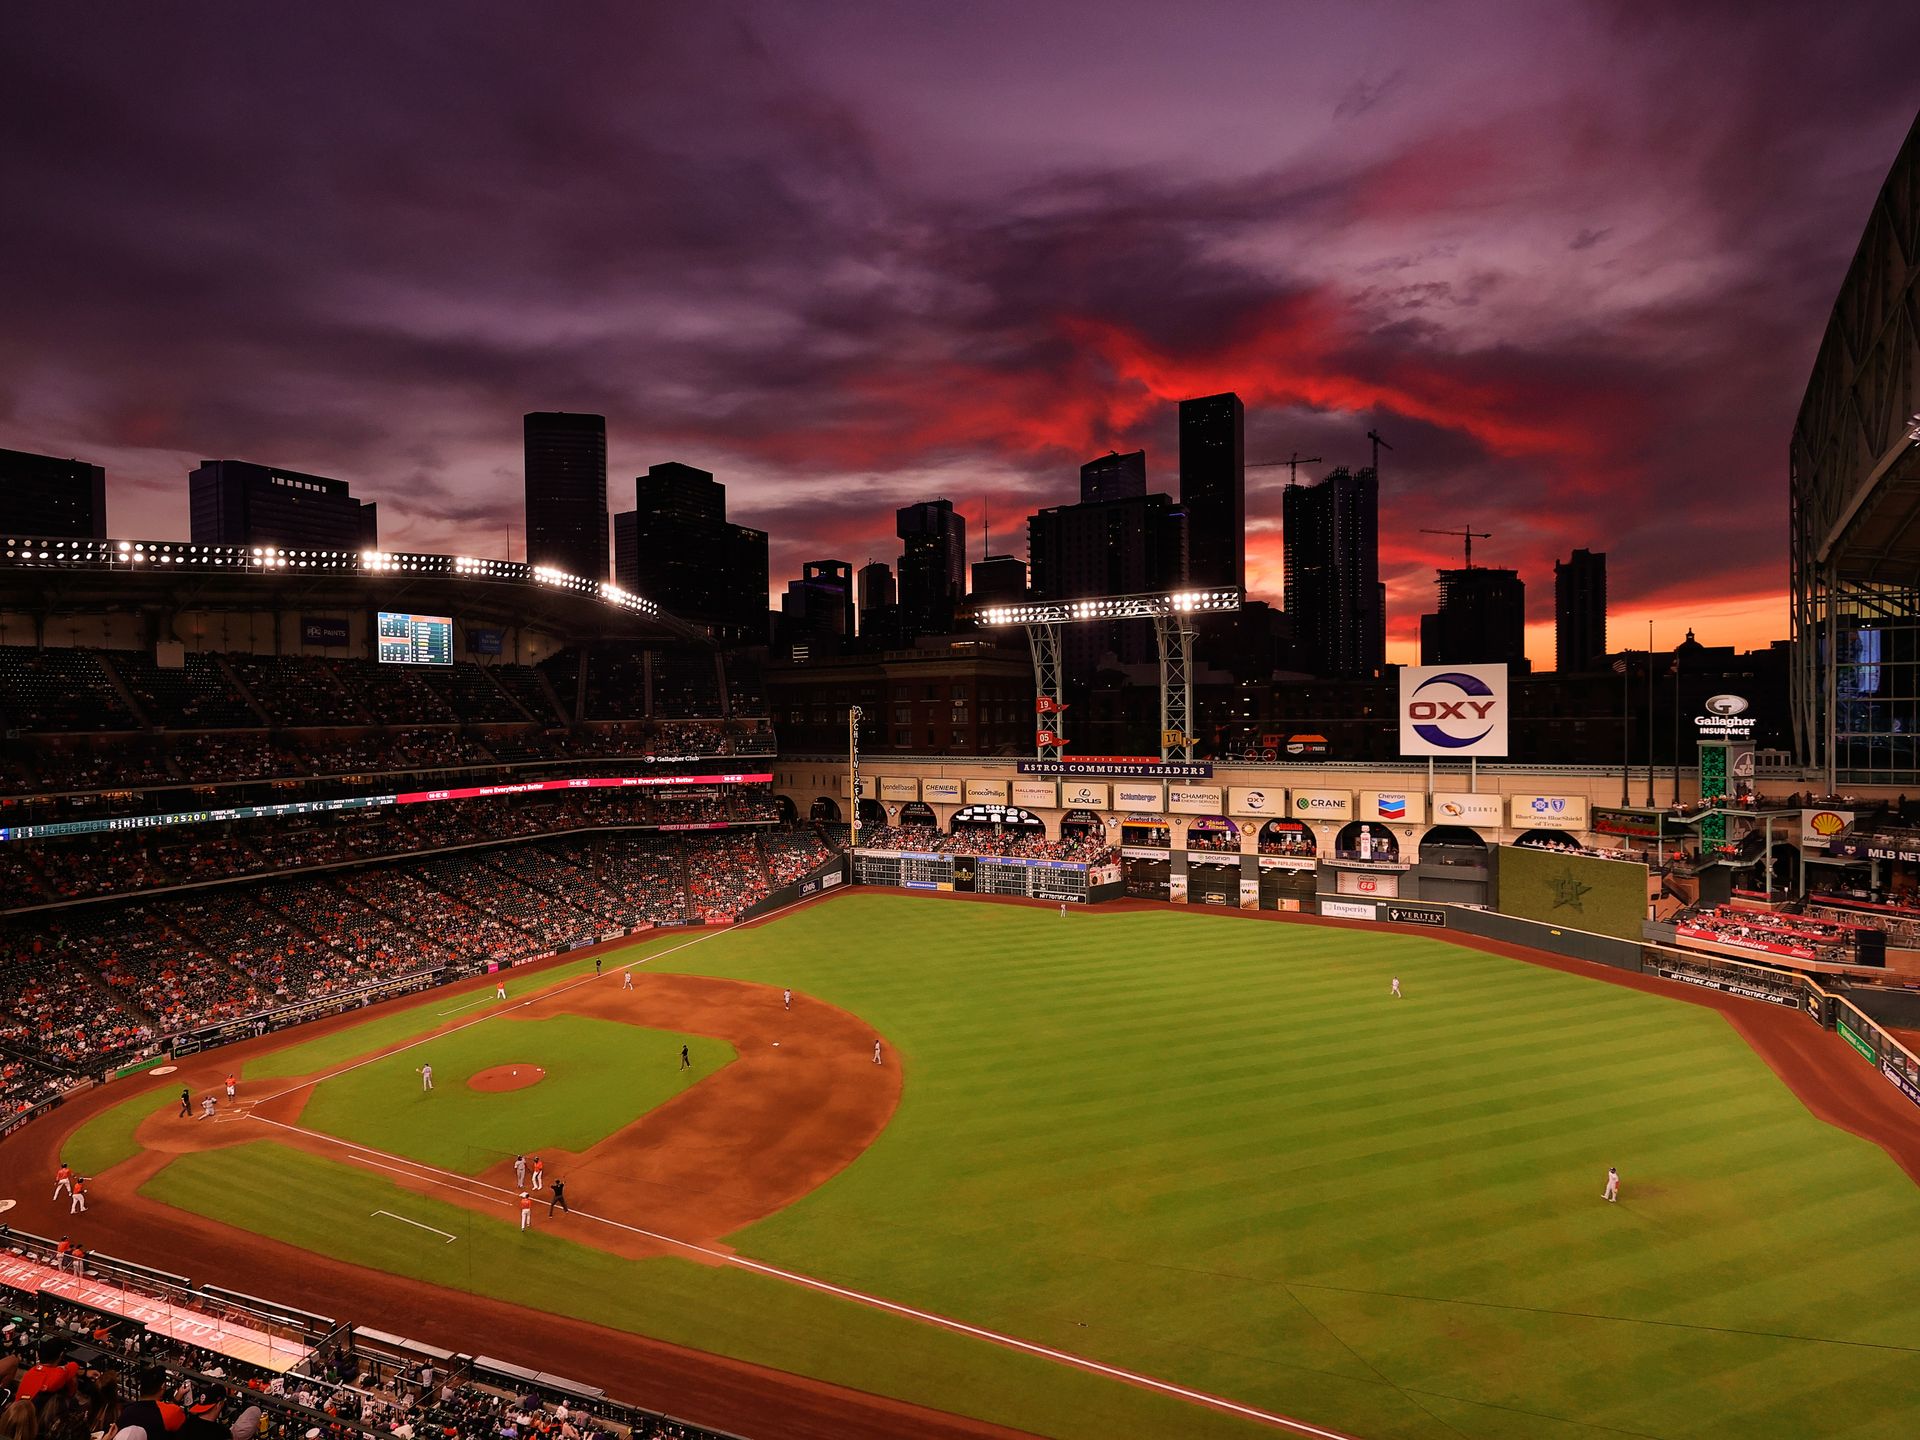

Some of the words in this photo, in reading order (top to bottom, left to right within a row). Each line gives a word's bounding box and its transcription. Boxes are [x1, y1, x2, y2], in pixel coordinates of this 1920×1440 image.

[324, 629, 346, 637] PAINTS
[1410, 701, 1496, 720] OXY
[1694, 716, 1756, 727] Gallagher
[1040, 734, 1049, 742] 05
[1166, 734, 1176, 742] 17
[1070, 764, 1144, 774] COMMUNITY
[1149, 766, 1206, 775] LEADERS
[968, 789, 1005, 798] ConocoPhillips
[1120, 792, 1156, 802] Schlumberger
[1310, 799, 1346, 808] CRANE
[1868, 848, 1896, 859] MLB
[1040, 892, 1078, 902] NITTOTIRE.COM
[1334, 904, 1368, 914] Insperity
[1401, 911, 1440, 921] VERITEX
[1716, 933, 1768, 950] Budweiser
[1671, 974, 1720, 990] NITTOTIRE.COM
[1729, 986, 1783, 1004] NITTOTIRE.COM
[5, 1116, 27, 1136] H-E-B
[40, 1278, 72, 1293] OF
[78, 1290, 121, 1312] THE
[128, 1306, 225, 1342] ASTROS
[273, 1384, 282, 1393] 27
